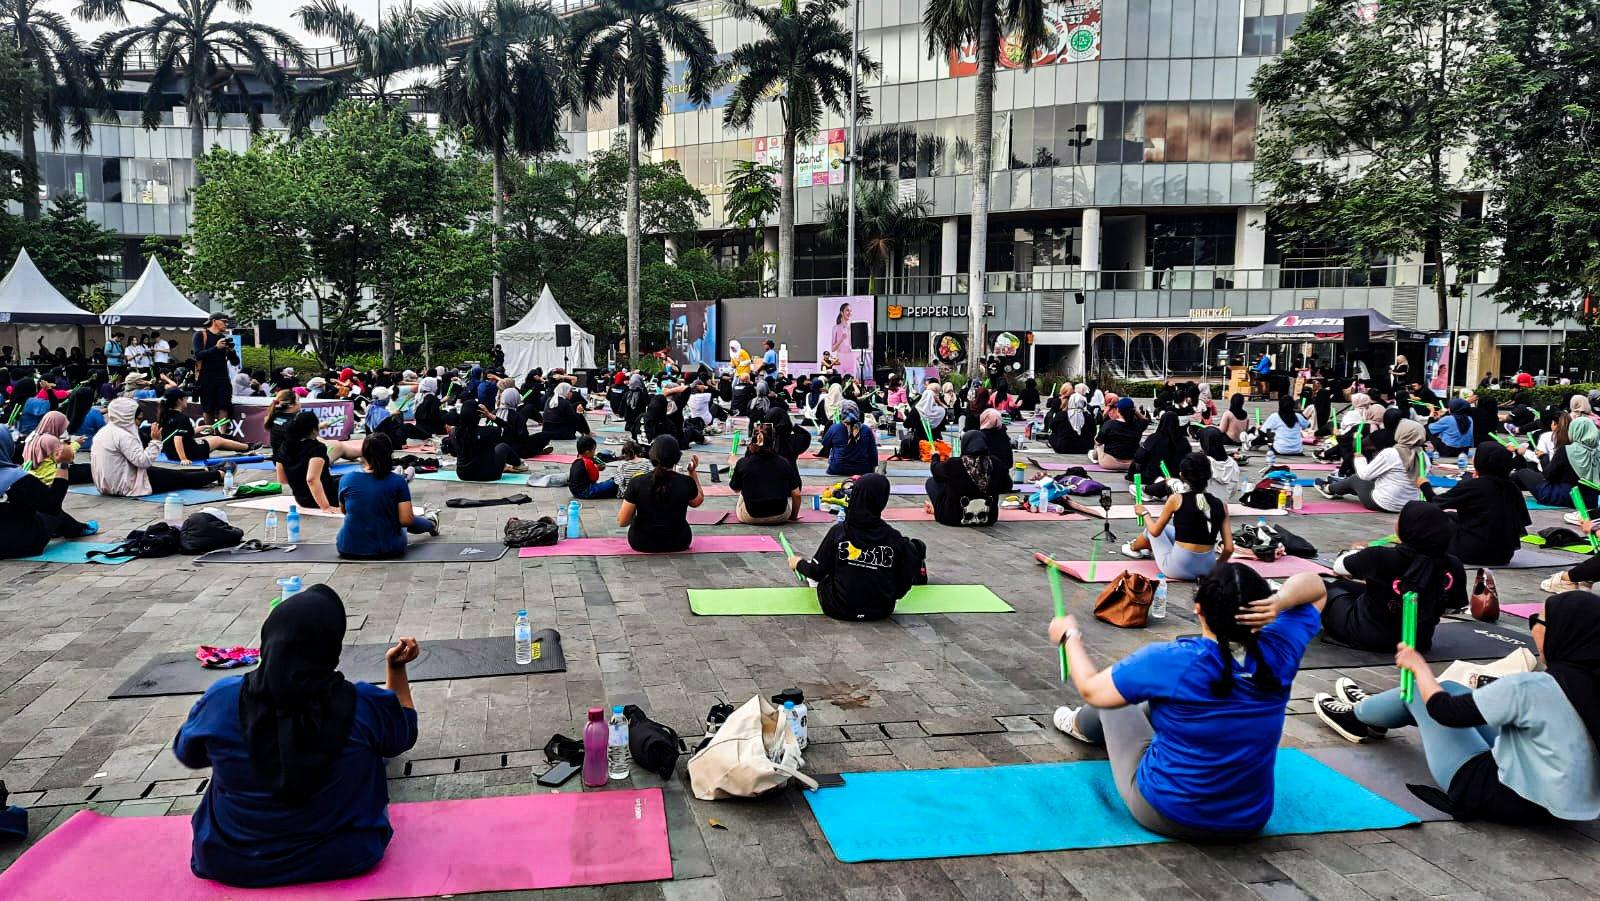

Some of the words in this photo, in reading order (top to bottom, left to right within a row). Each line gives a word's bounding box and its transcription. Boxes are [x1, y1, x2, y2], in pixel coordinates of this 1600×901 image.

[906, 306, 949, 317] PEPPER
[951, 303, 996, 317] LUH
[99, 315, 121, 325] VIP
[320, 406, 345, 417] RUN
[319, 426, 344, 438] OUT
